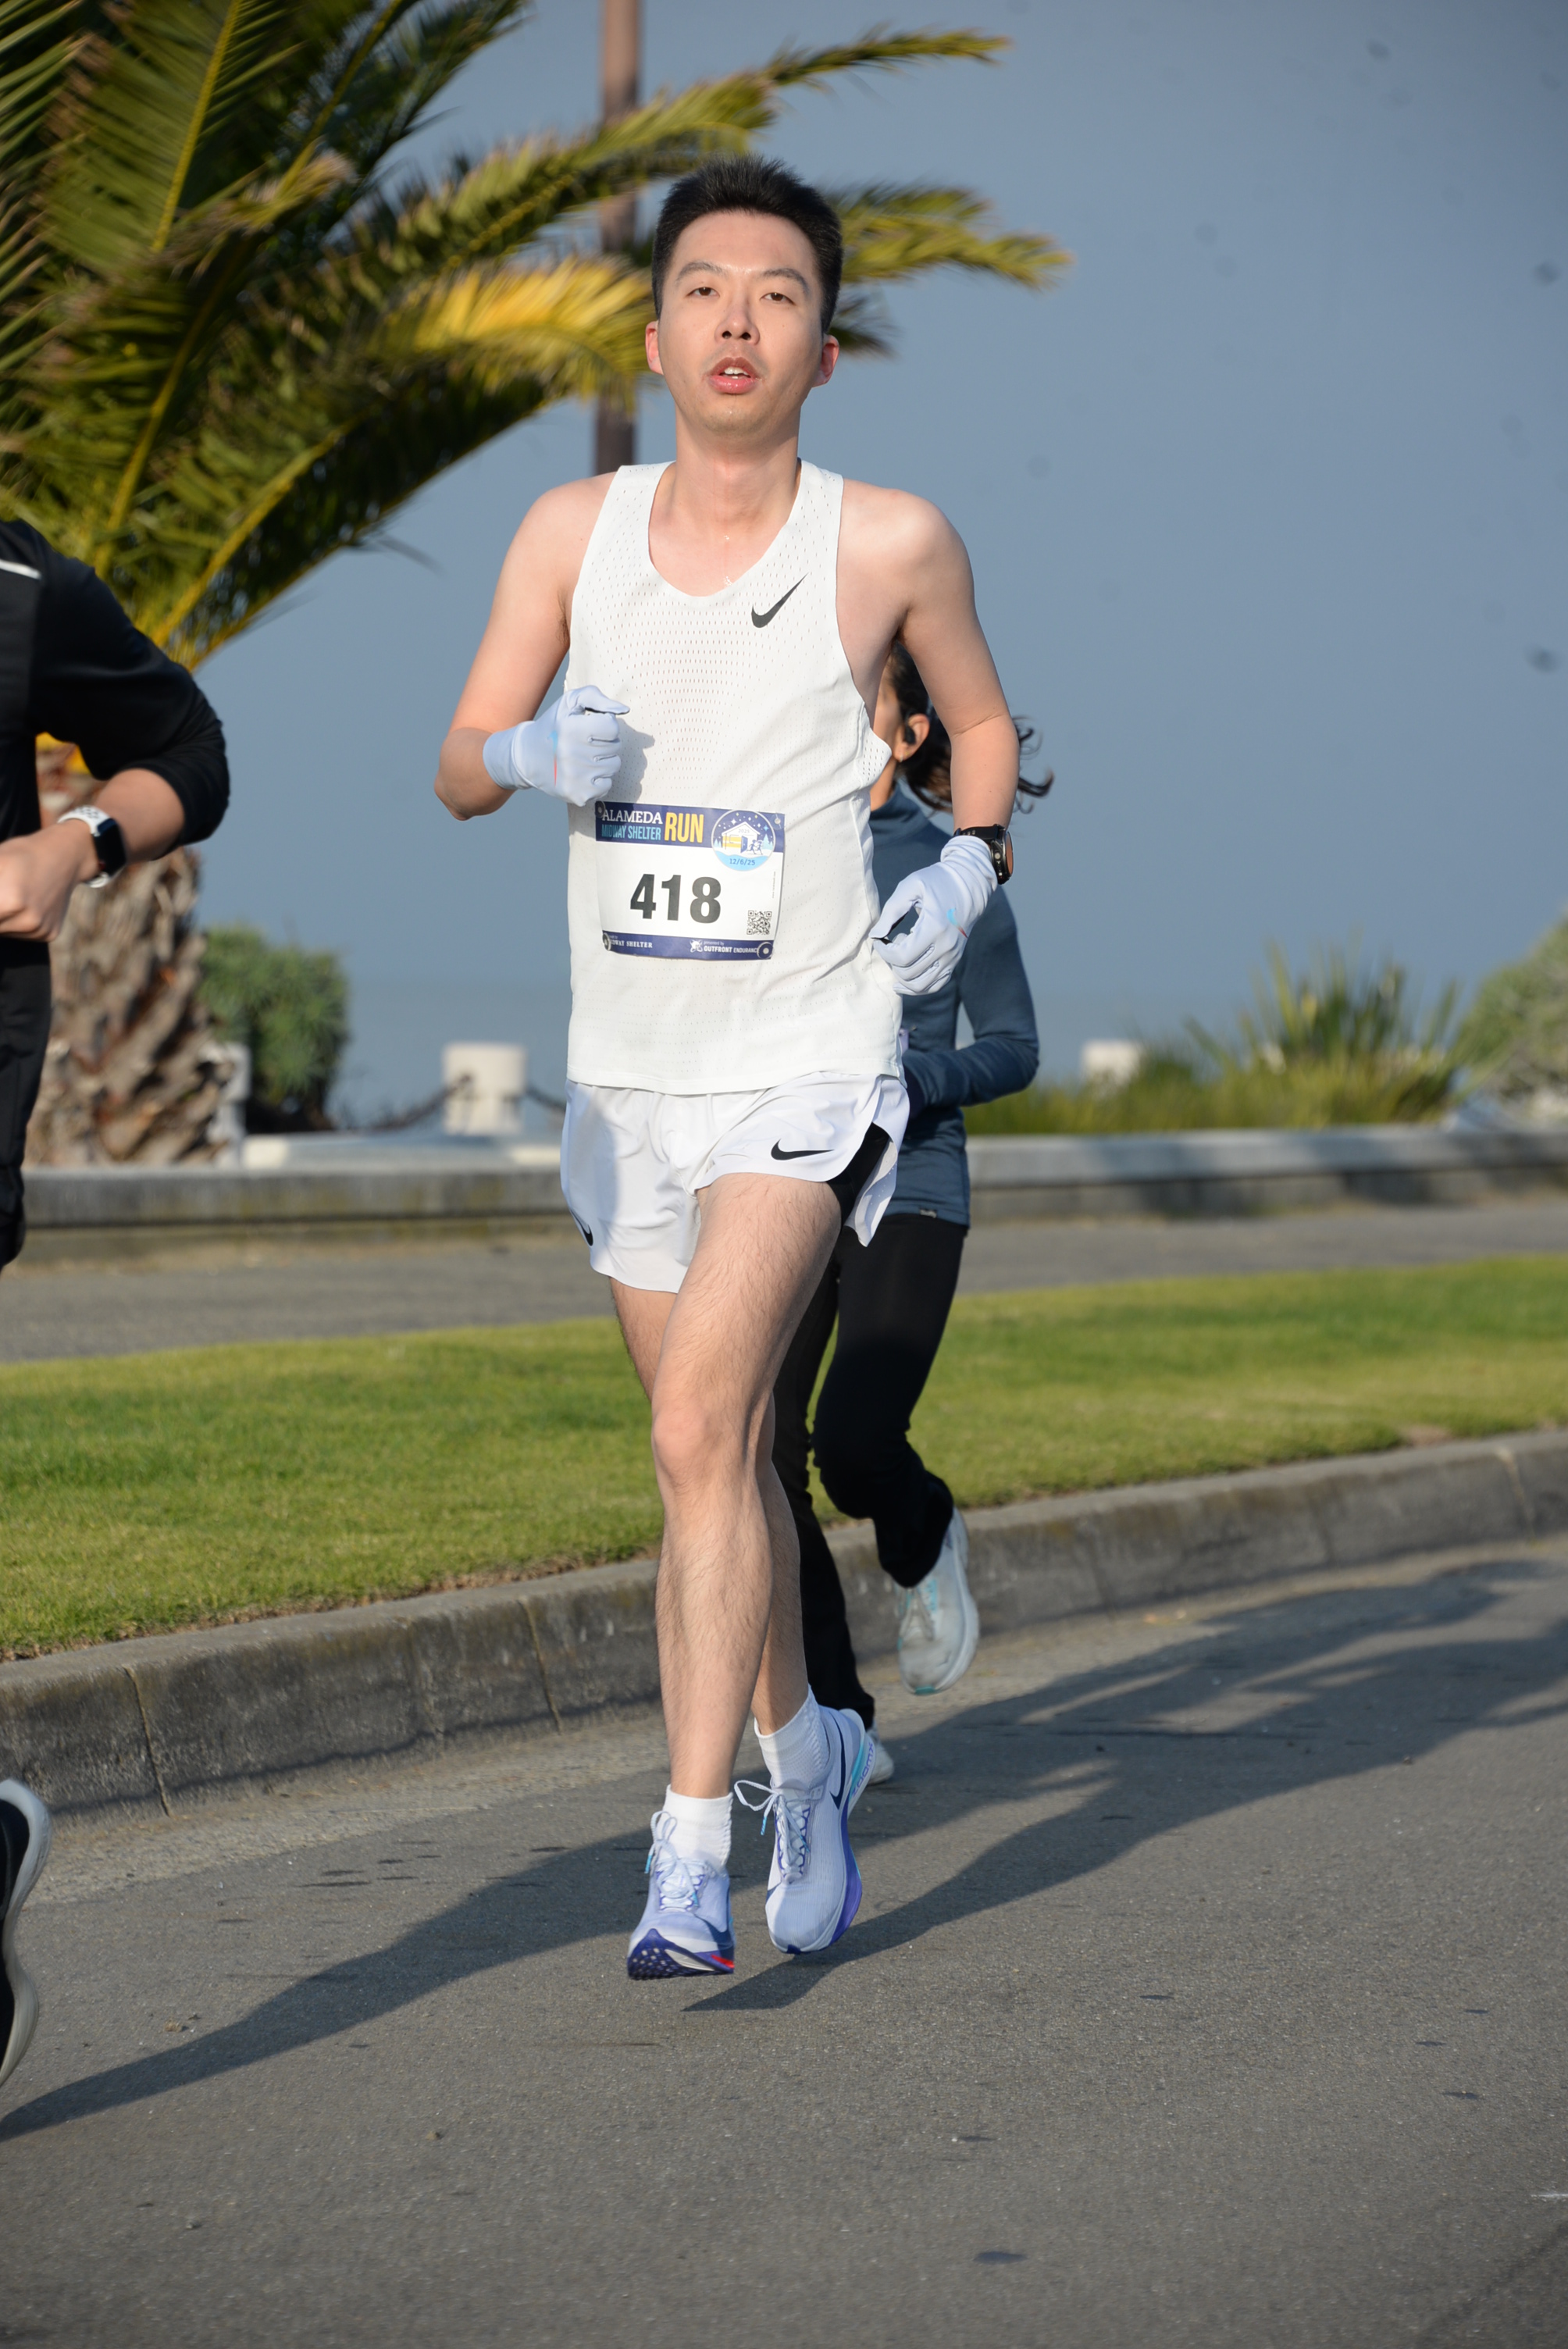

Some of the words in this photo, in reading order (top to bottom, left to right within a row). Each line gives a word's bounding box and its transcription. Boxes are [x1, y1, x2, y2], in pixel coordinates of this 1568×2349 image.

[601, 809, 663, 825] ALAMEDA
[664, 811, 704, 843] RUN
[601, 824, 626, 839] MIDWAY
[627, 825, 661, 841] SHELTER
[630, 873, 722, 924] 418
